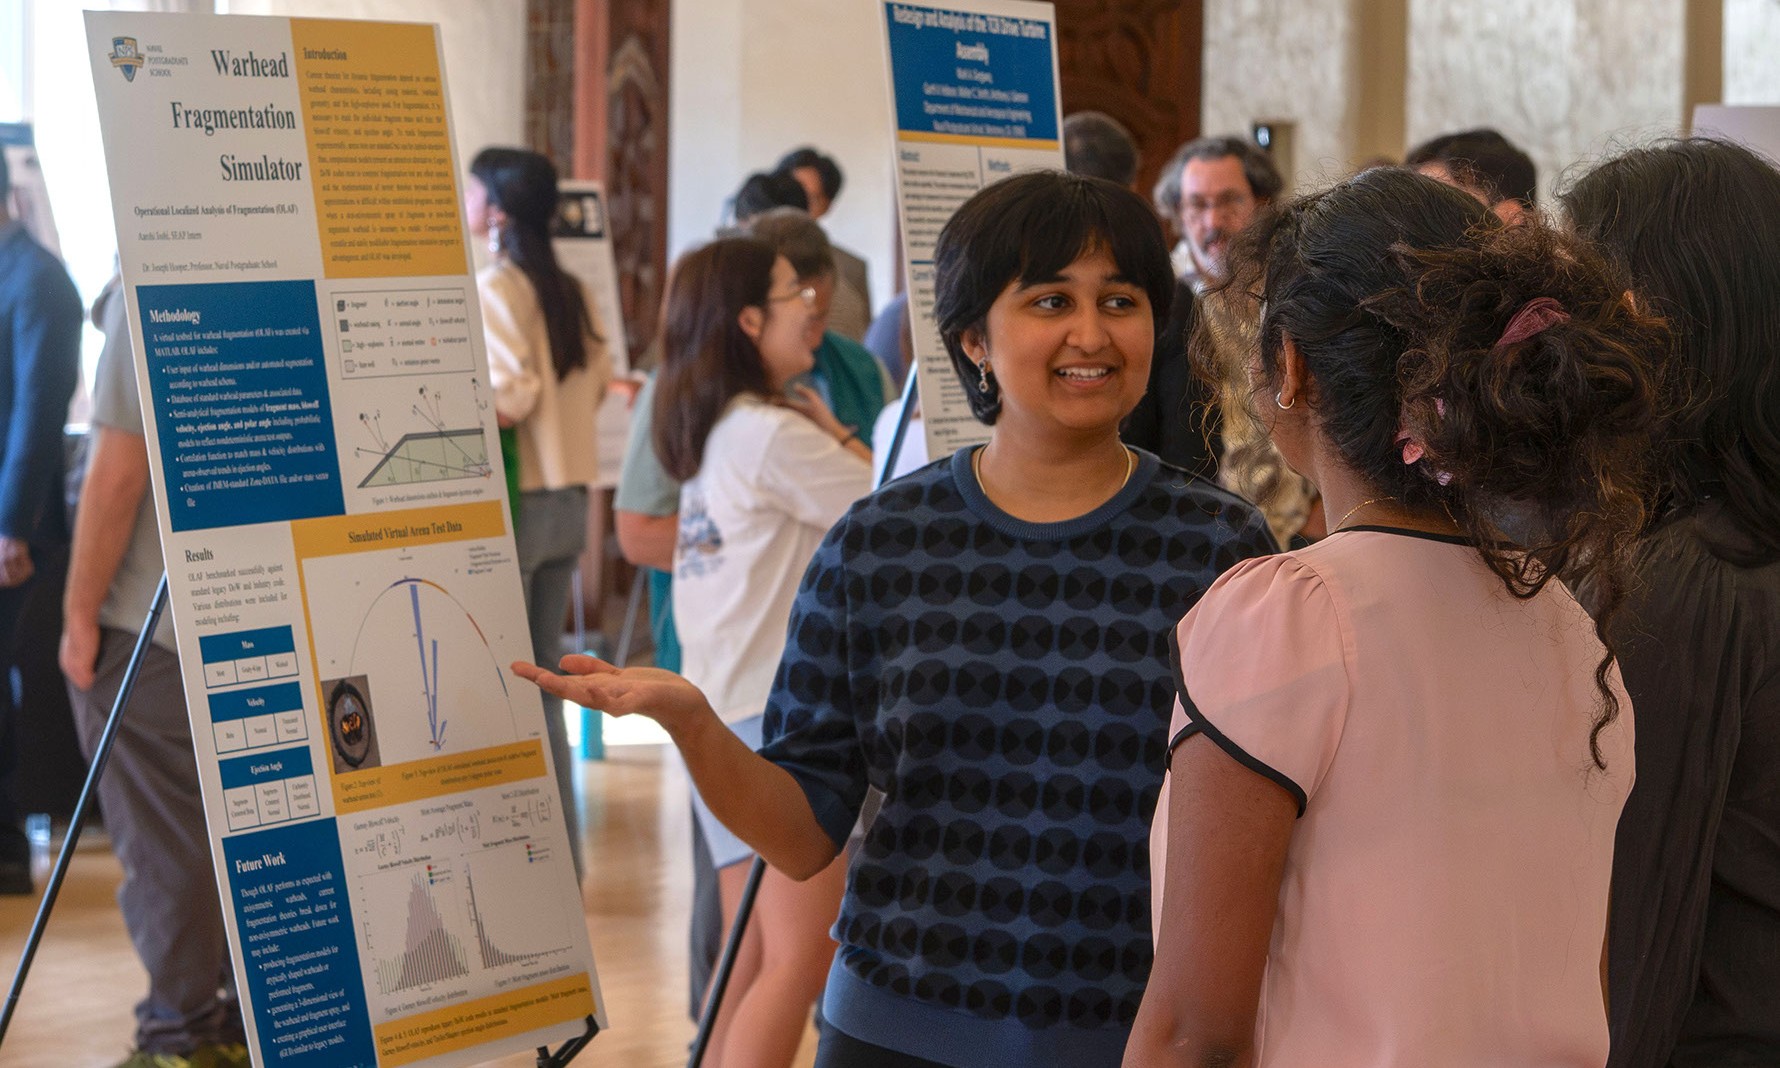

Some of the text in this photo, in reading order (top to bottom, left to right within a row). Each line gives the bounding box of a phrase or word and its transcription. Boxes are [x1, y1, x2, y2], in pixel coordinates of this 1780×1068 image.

[211, 50, 289, 78] Warhead
[303, 47, 347, 60] Introduction
[170, 102, 297, 137] Fragmentation
[220, 154, 303, 182] Simulator
[133, 205, 171, 219] Operational
[170, 204, 200, 216] Localized
[200, 204, 225, 218] Analysis
[232, 203, 275, 217] Fragmentation
[274, 203, 299, 216] (OLAF)
[149, 308, 202, 325] Methodology
[348, 520, 463, 545] Simulated Virtual Arena Test Data
[184, 547, 214, 563] Results
[235, 850, 286, 874] Future Work
